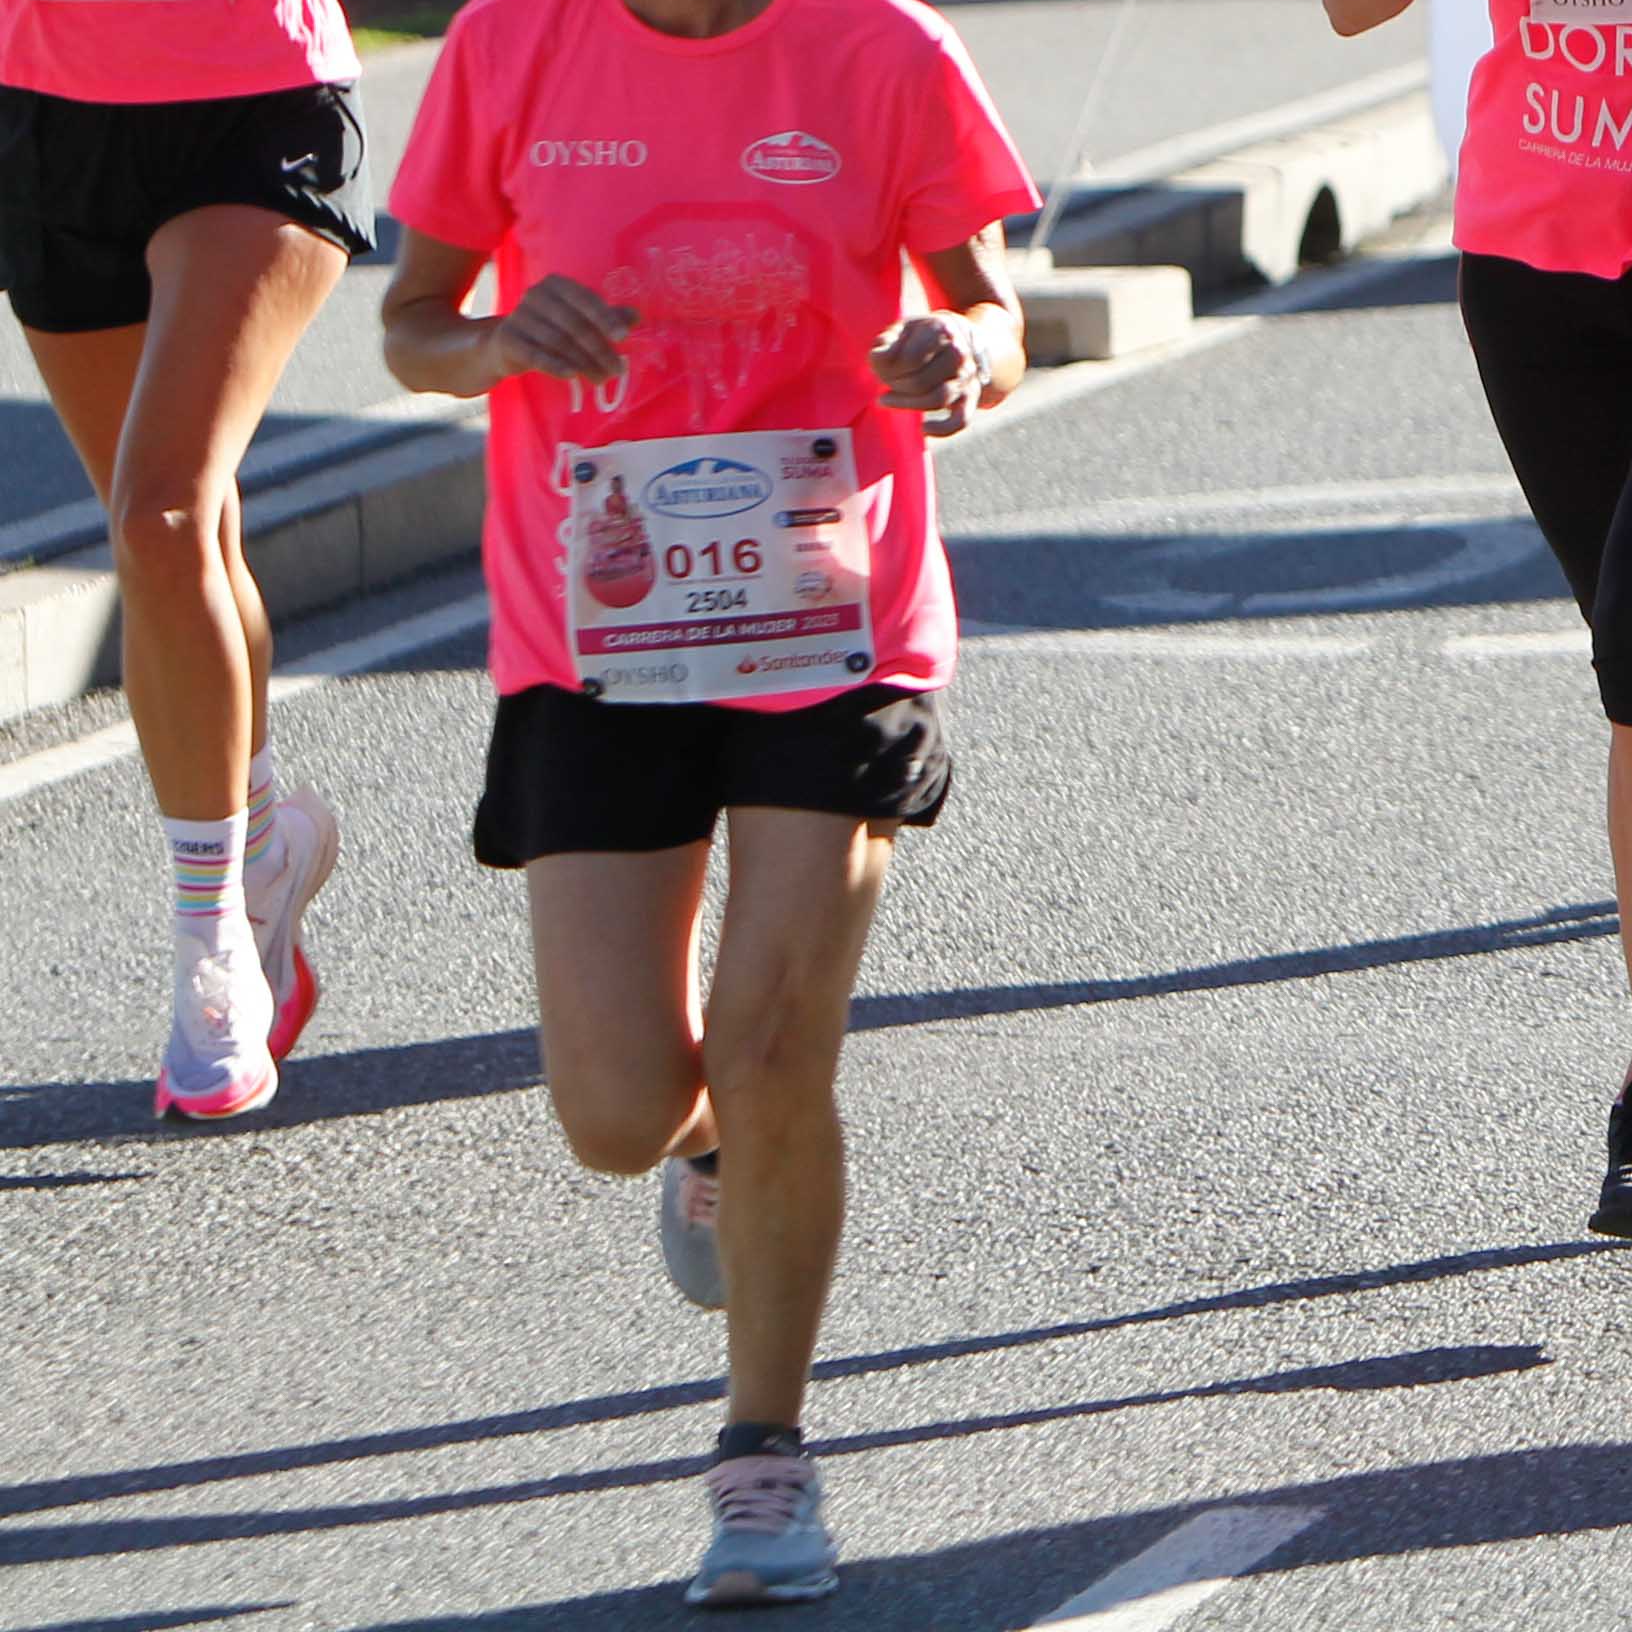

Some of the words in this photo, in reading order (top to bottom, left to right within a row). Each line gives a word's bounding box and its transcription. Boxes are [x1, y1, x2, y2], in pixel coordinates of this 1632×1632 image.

[529, 139, 648, 168] OYSHO
[1519, 138, 1566, 162] CARRERA
[1567, 152, 1583, 166] DE
[1585, 154, 1600, 169] LA
[665, 538, 764, 579] 016
[684, 588, 750, 614] 2504
[603, 631, 683, 649] CARRERA
[686, 626, 710, 641] DE
[713, 624, 737, 639] LA
[739, 618, 797, 636] MUJER
[602, 663, 689, 686] OYSHO
